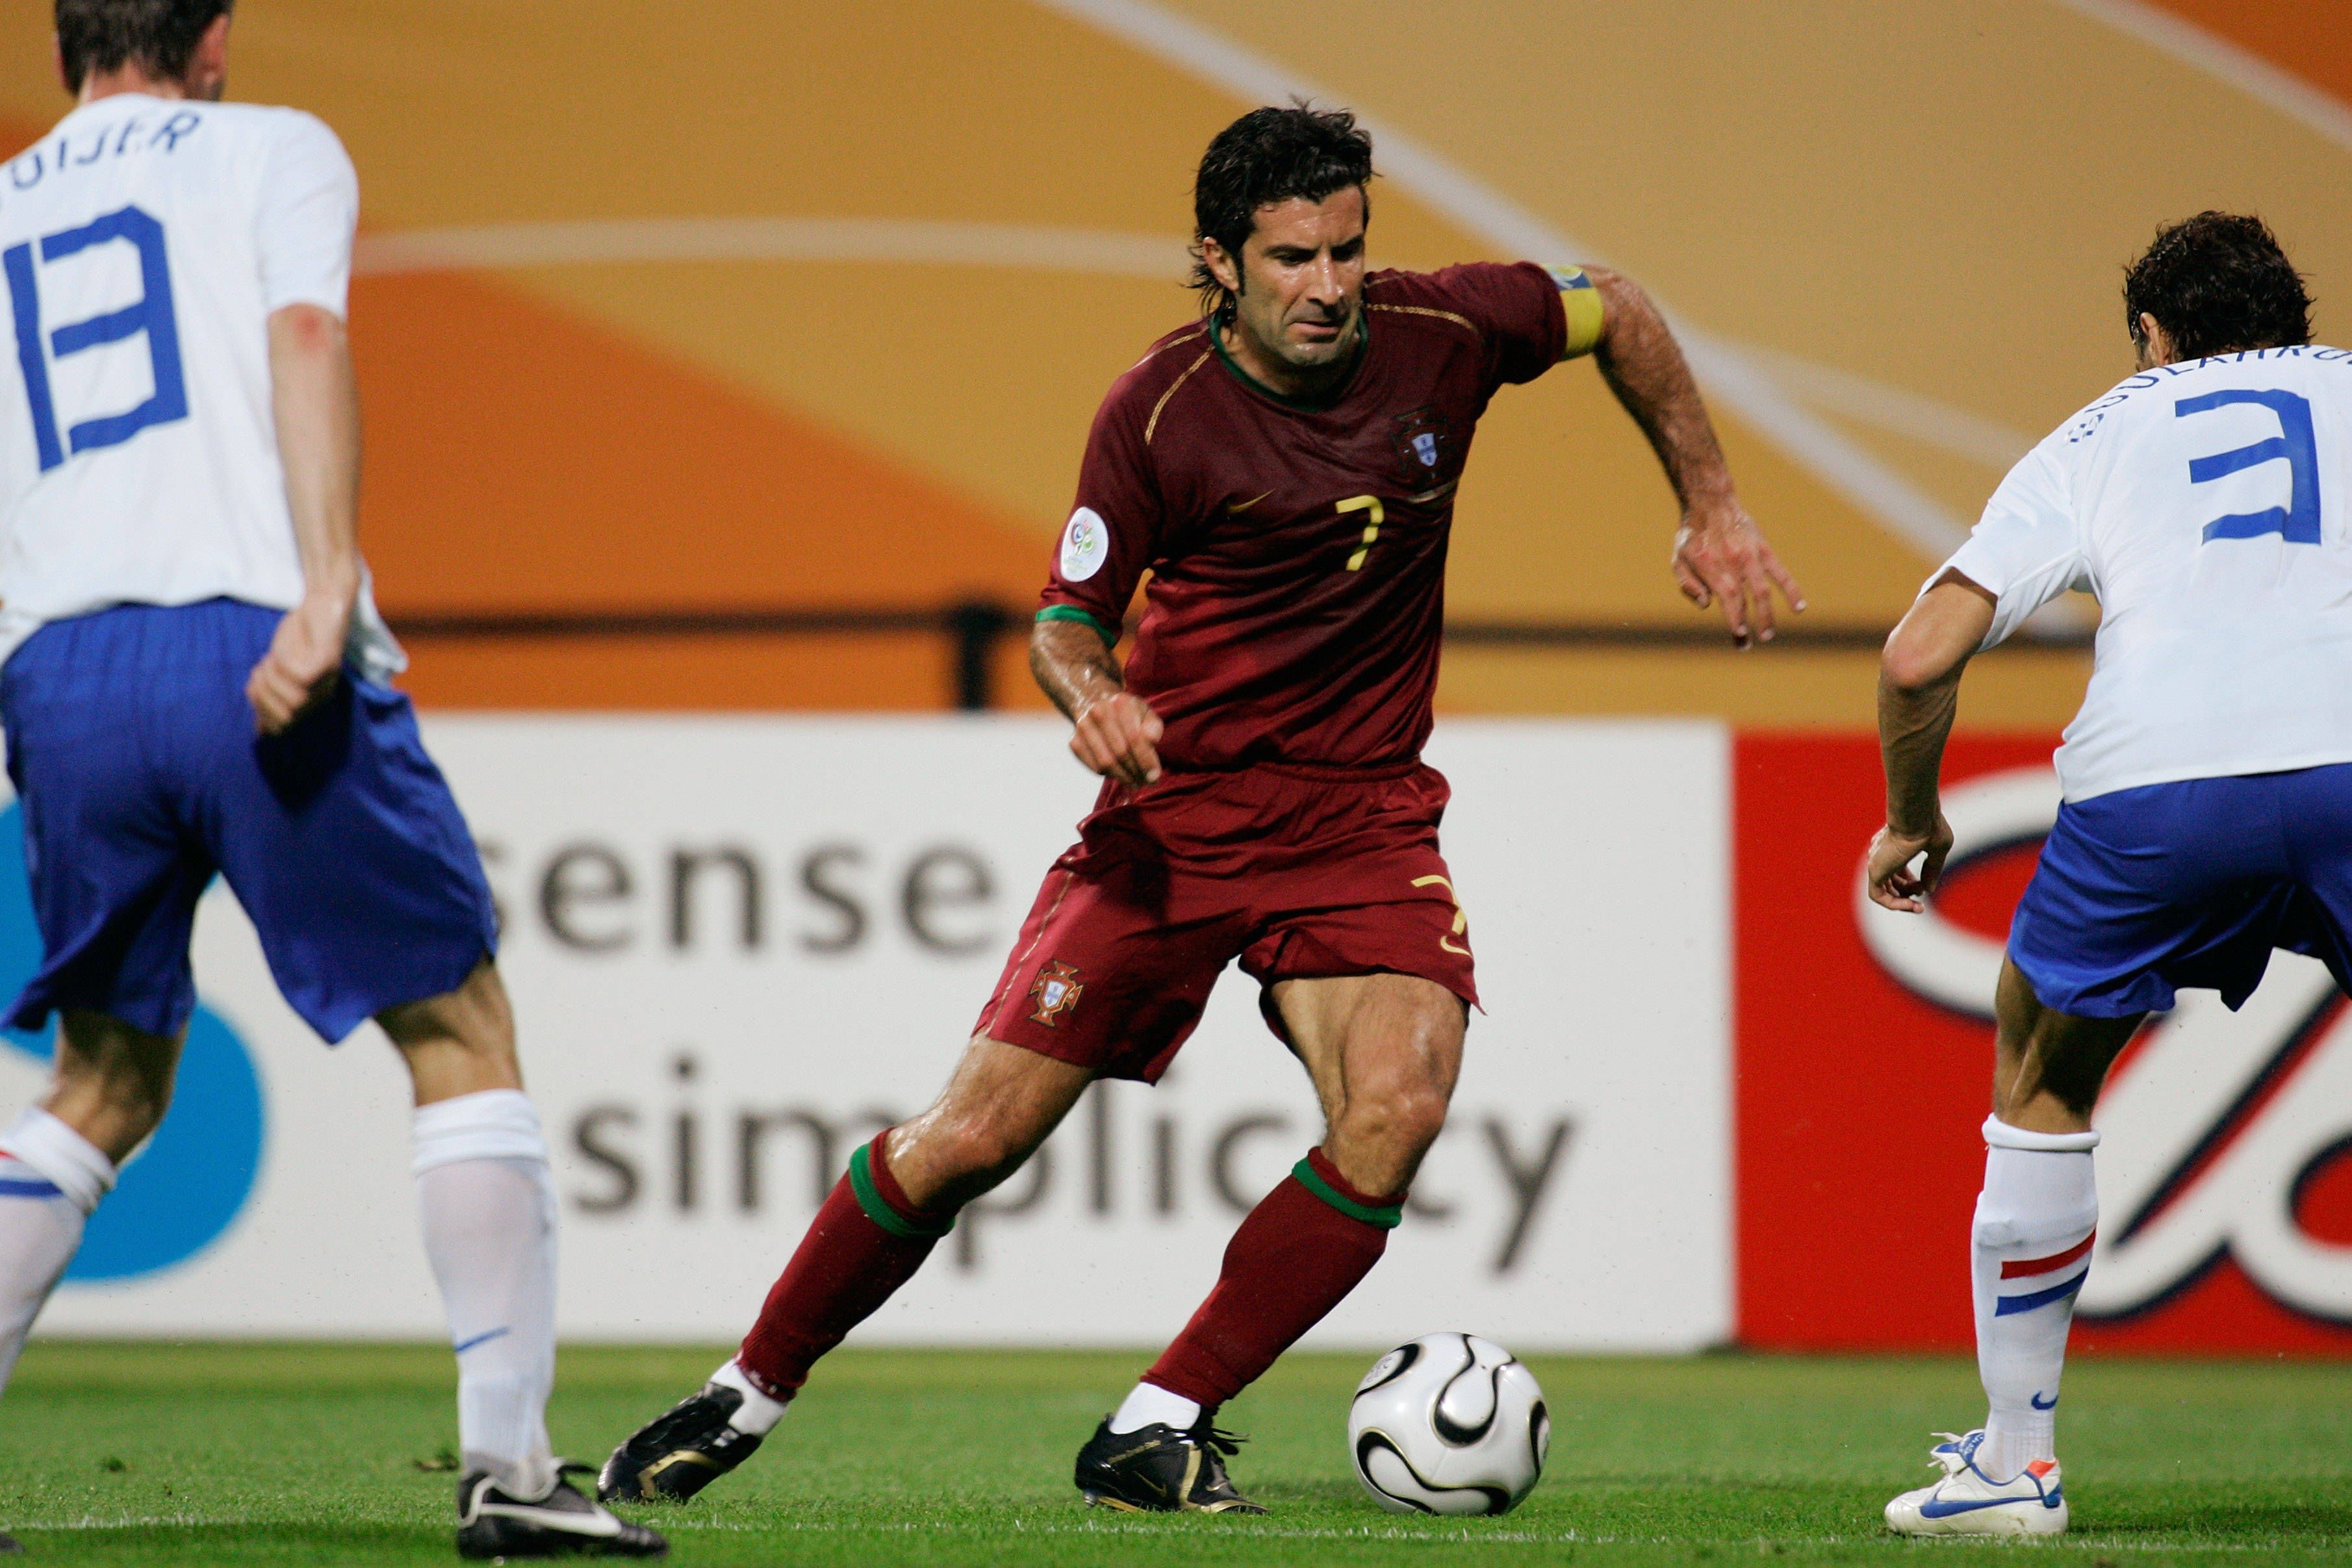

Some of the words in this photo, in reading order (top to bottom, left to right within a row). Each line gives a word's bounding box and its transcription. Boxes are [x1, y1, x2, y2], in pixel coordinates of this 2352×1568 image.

[2, 204, 188, 474] 13
[1335, 494, 1385, 572] 7
[2174, 388, 2323, 546] 3
